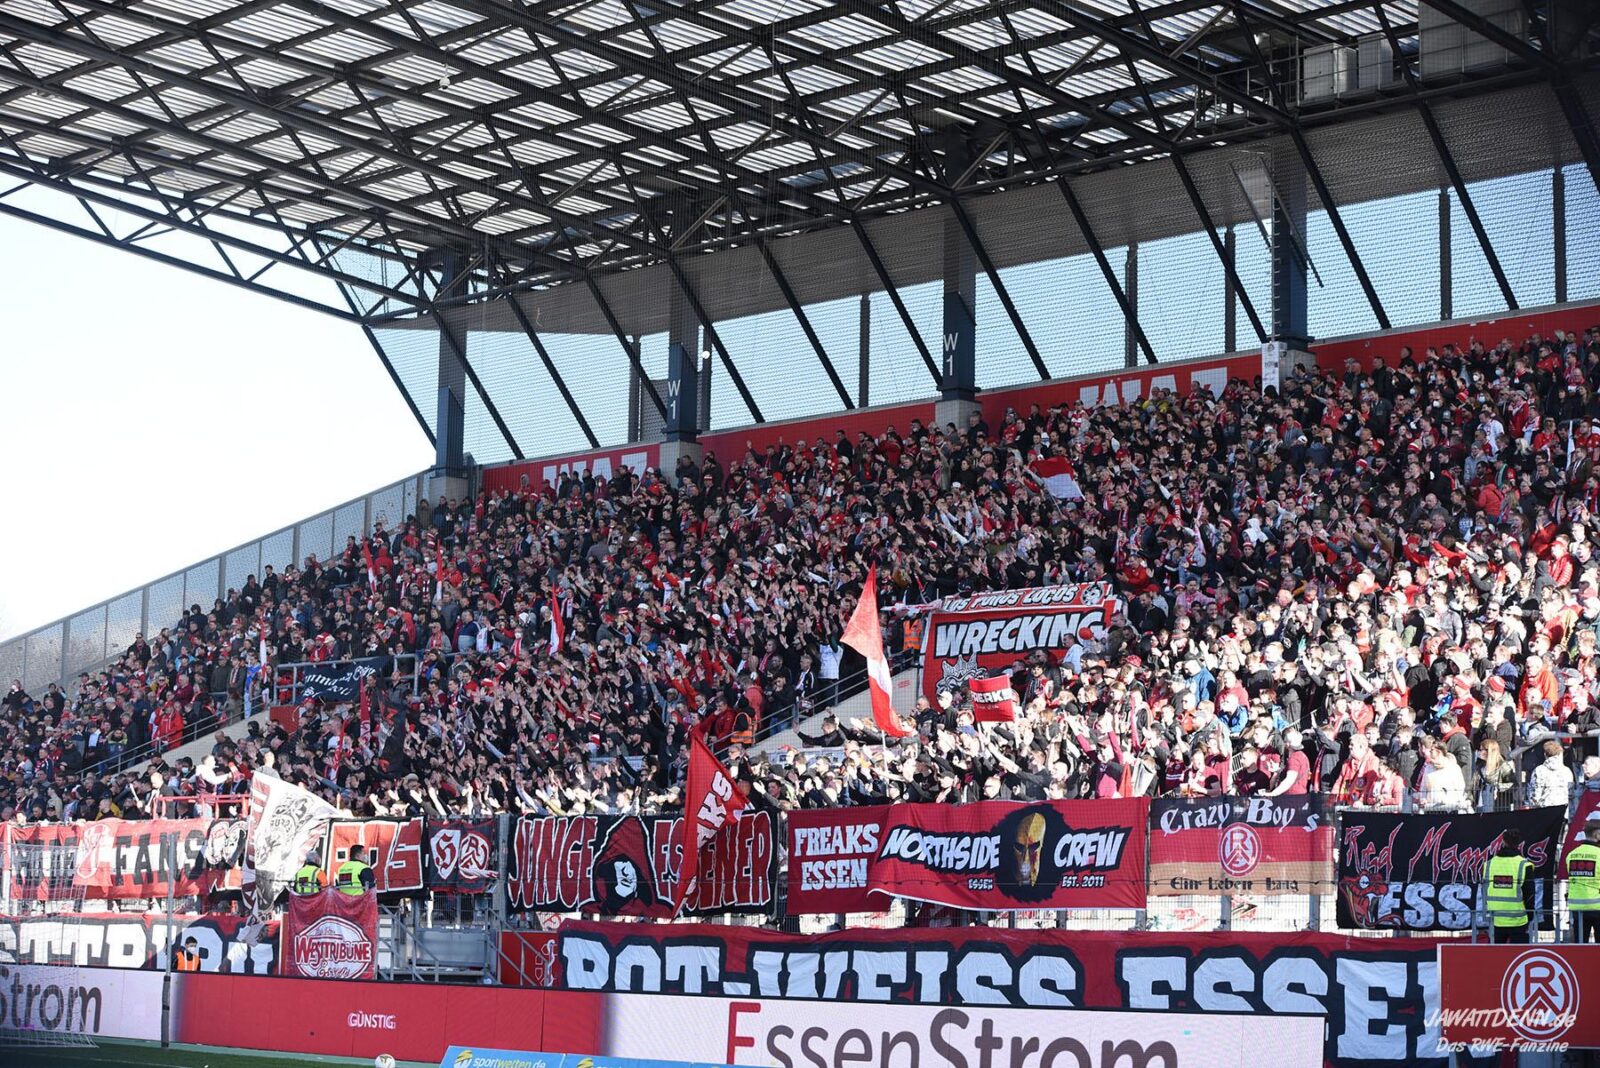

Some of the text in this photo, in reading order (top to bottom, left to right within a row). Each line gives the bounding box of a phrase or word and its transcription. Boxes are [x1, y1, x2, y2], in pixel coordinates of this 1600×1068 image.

[943, 332, 959, 352] W
[946, 354, 953, 376] 1
[667, 379, 681, 397] W
[670, 400, 676, 420] 1
[1022, 585, 1078, 605] LOCOS
[935, 611, 1104, 658] WRECKING
[1160, 802, 1230, 837] Crazy
[793, 823, 881, 857] FREAKS
[881, 826, 1126, 870] NORTHSIDE CREW
[115, 829, 207, 887] FANS
[508, 815, 598, 909] JUNGE
[652, 810, 773, 911] ESENER
[800, 857, 869, 891] ESSEN
[968, 877, 994, 890] ESSEN
[1061, 875, 1104, 888] EST. 2011
[473, 1056, 546, 1068] sportwetten.de
